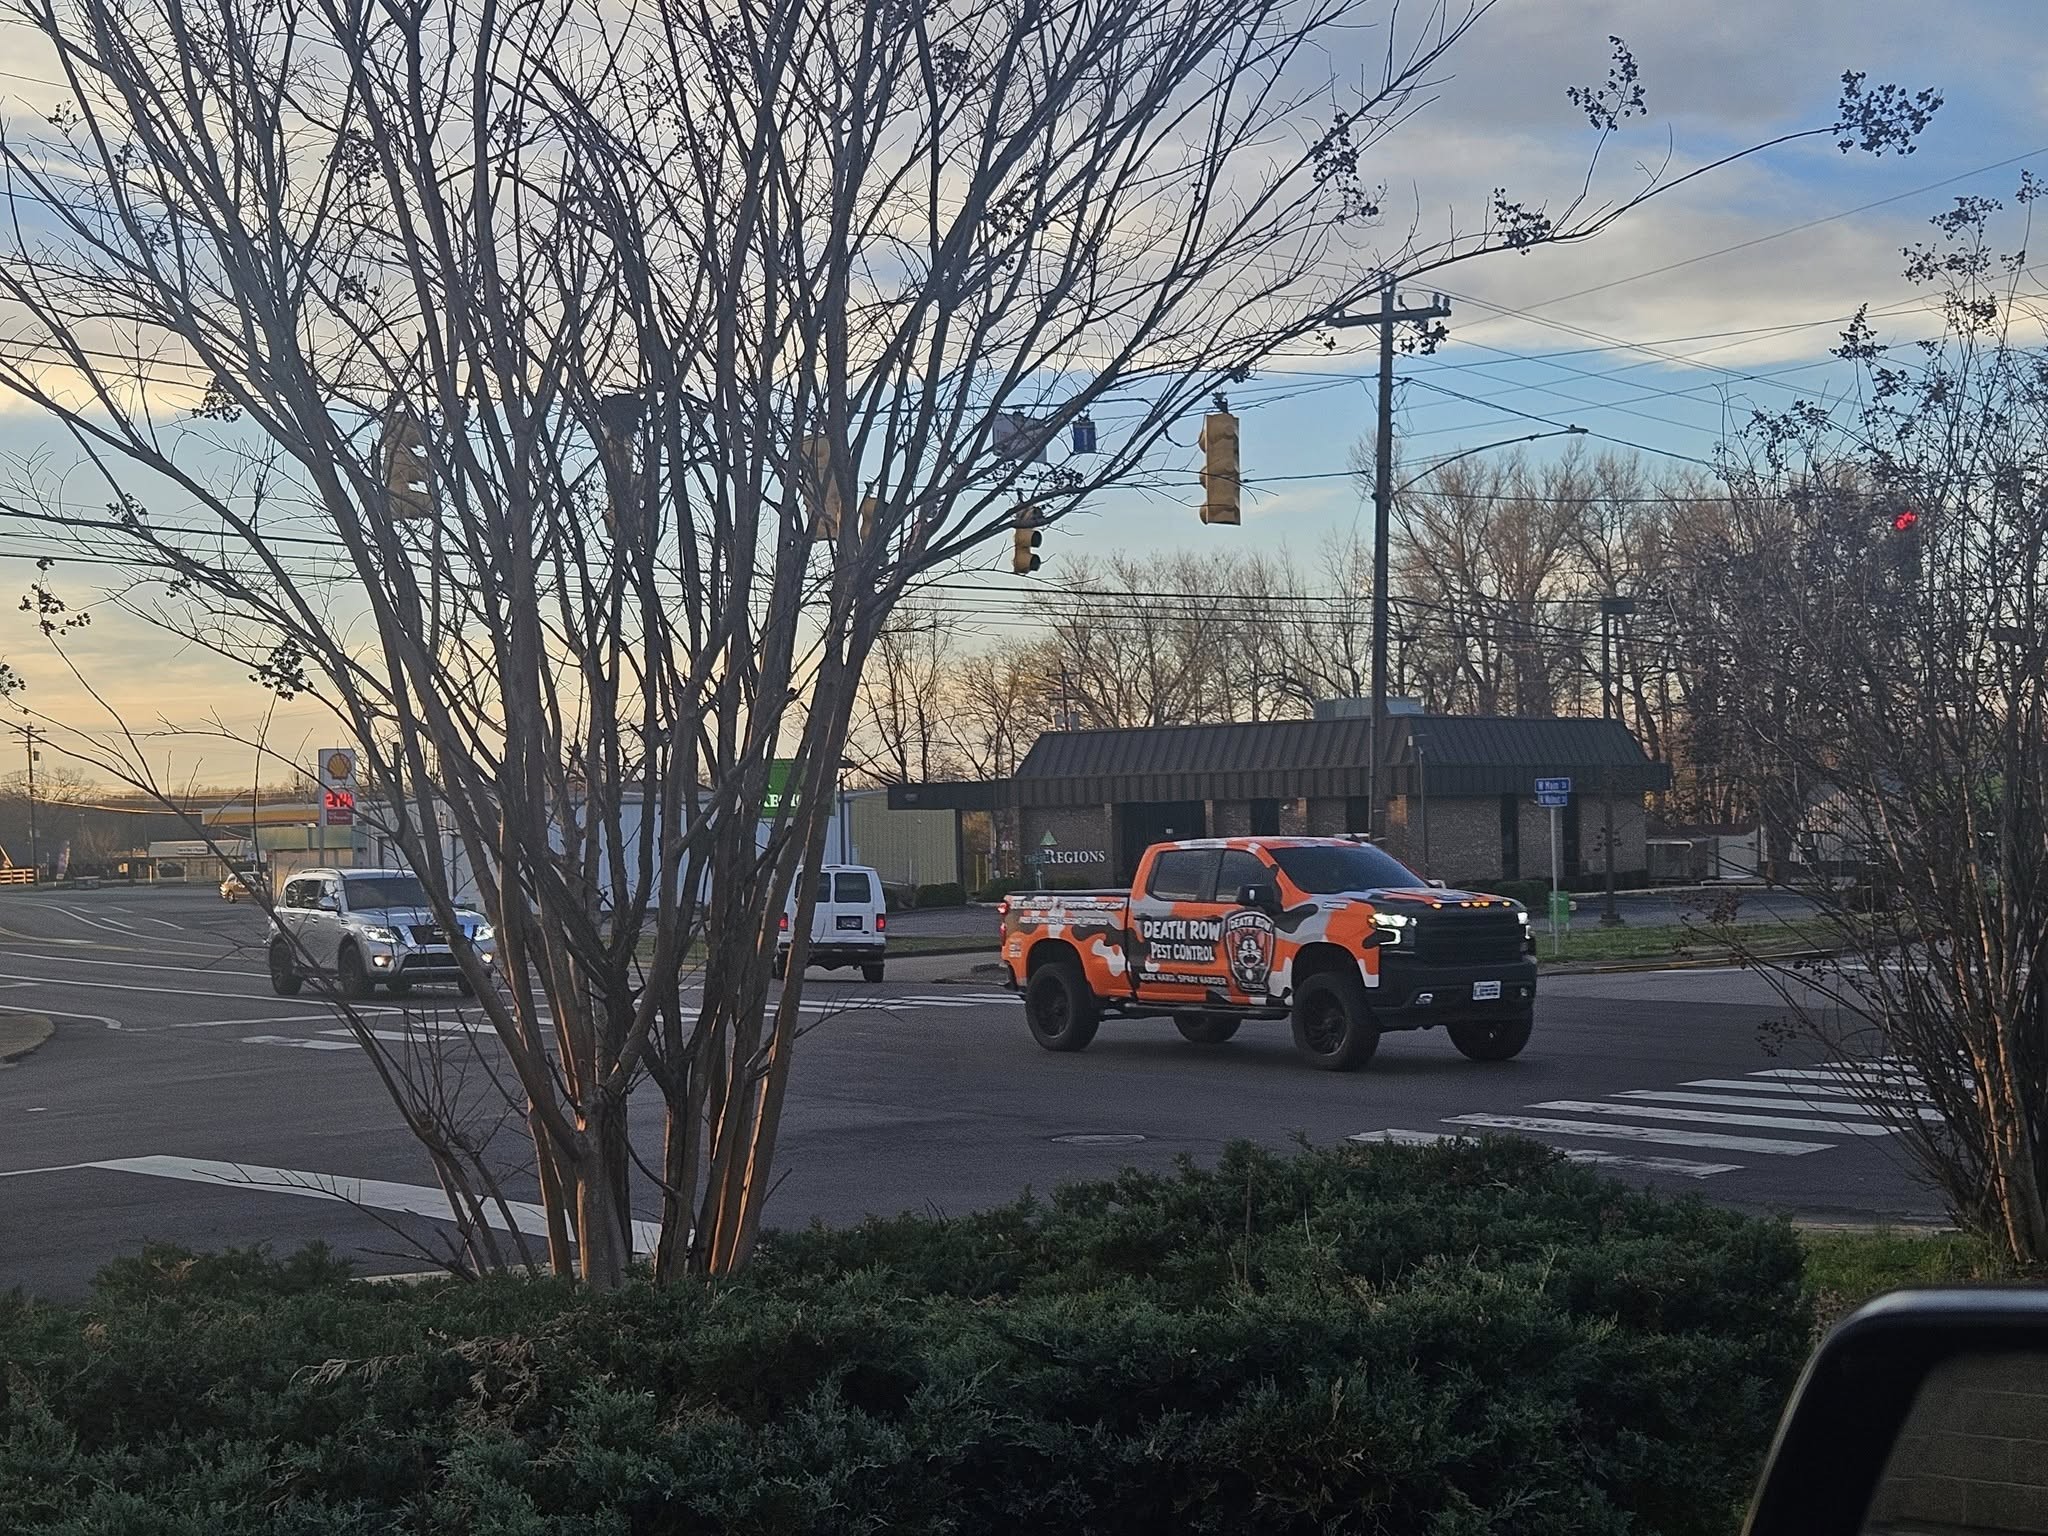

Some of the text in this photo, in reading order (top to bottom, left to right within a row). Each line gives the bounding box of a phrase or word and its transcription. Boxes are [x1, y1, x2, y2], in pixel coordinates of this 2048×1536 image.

[1044, 849, 1105, 864] REGIONS
[1143, 920, 1222, 942] DEATH ROW
[1231, 915, 1272, 932] DEATH ROW
[1150, 942, 1215, 961] PEST CONTROL
[1177, 975, 1198, 984] SPRAY
[1199, 976, 1228, 986] HARDER
